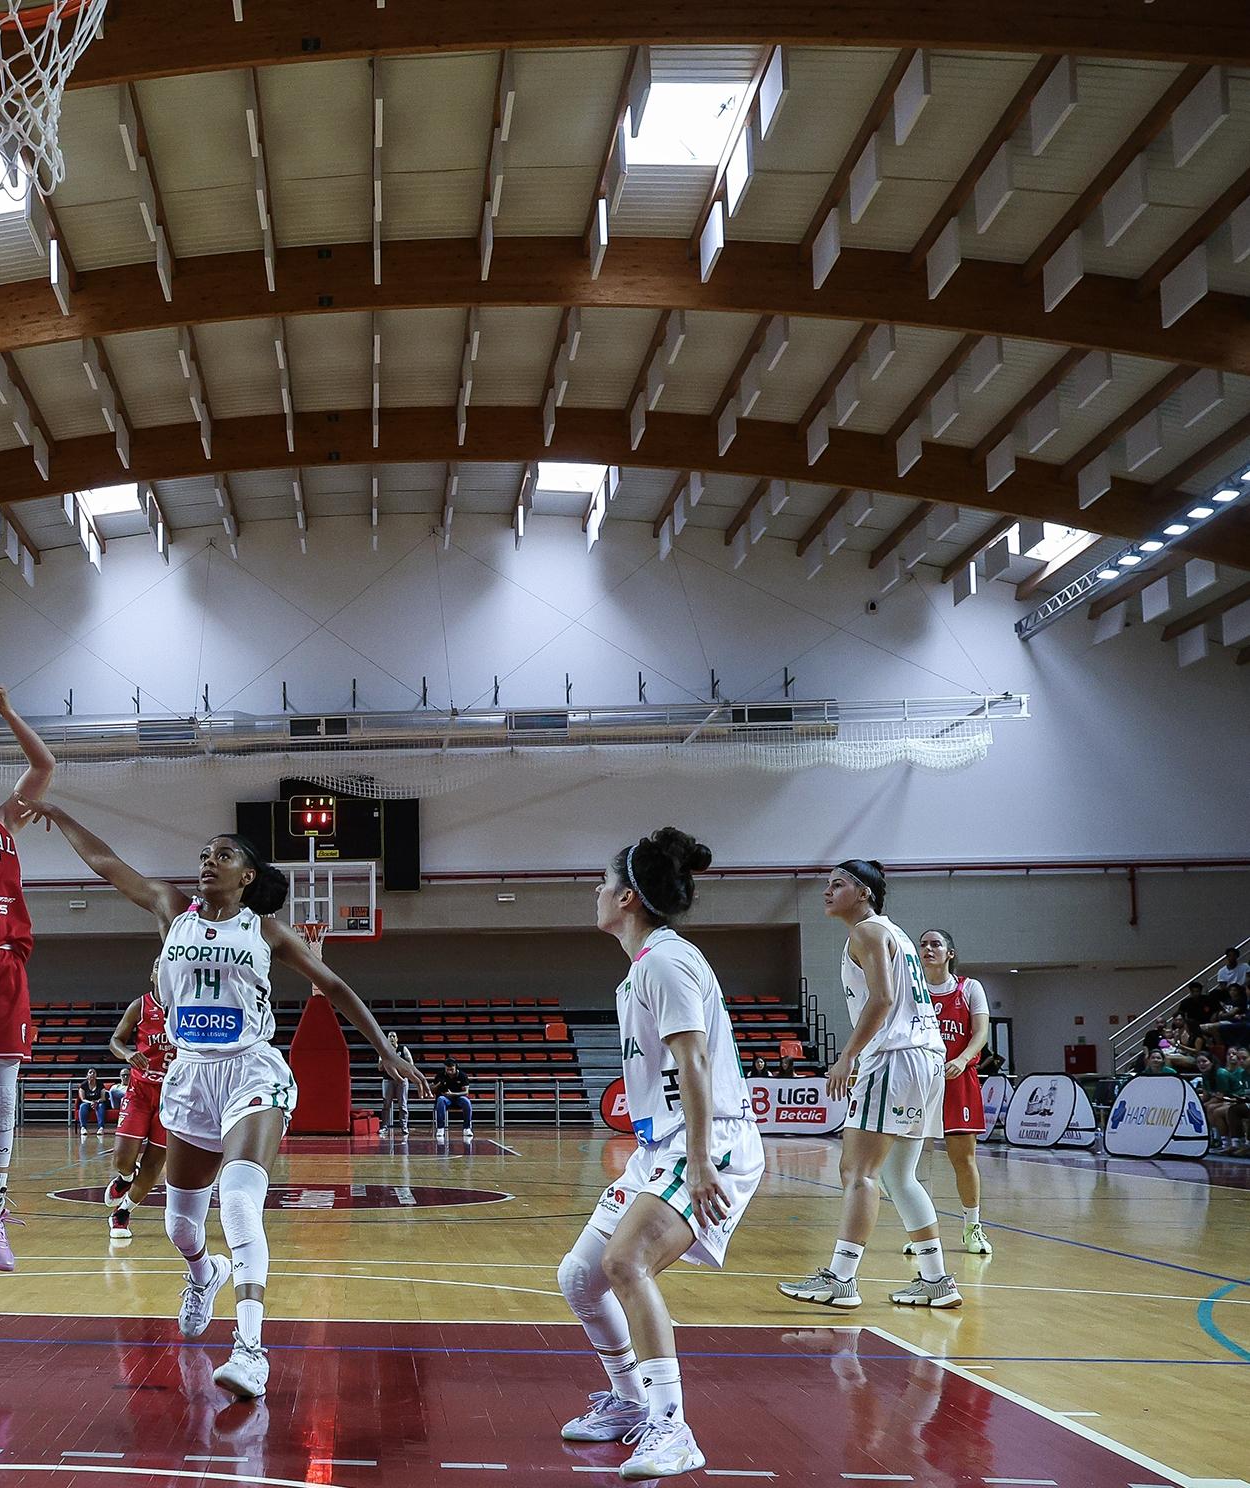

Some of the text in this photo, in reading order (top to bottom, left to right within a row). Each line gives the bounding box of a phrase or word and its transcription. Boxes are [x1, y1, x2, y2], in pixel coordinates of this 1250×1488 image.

[167, 945, 254, 968] SPORTIVA
[193, 968, 221, 1000] 14
[180, 1014, 236, 1030] AZORIS
[779, 1109, 822, 1121] Betclic
